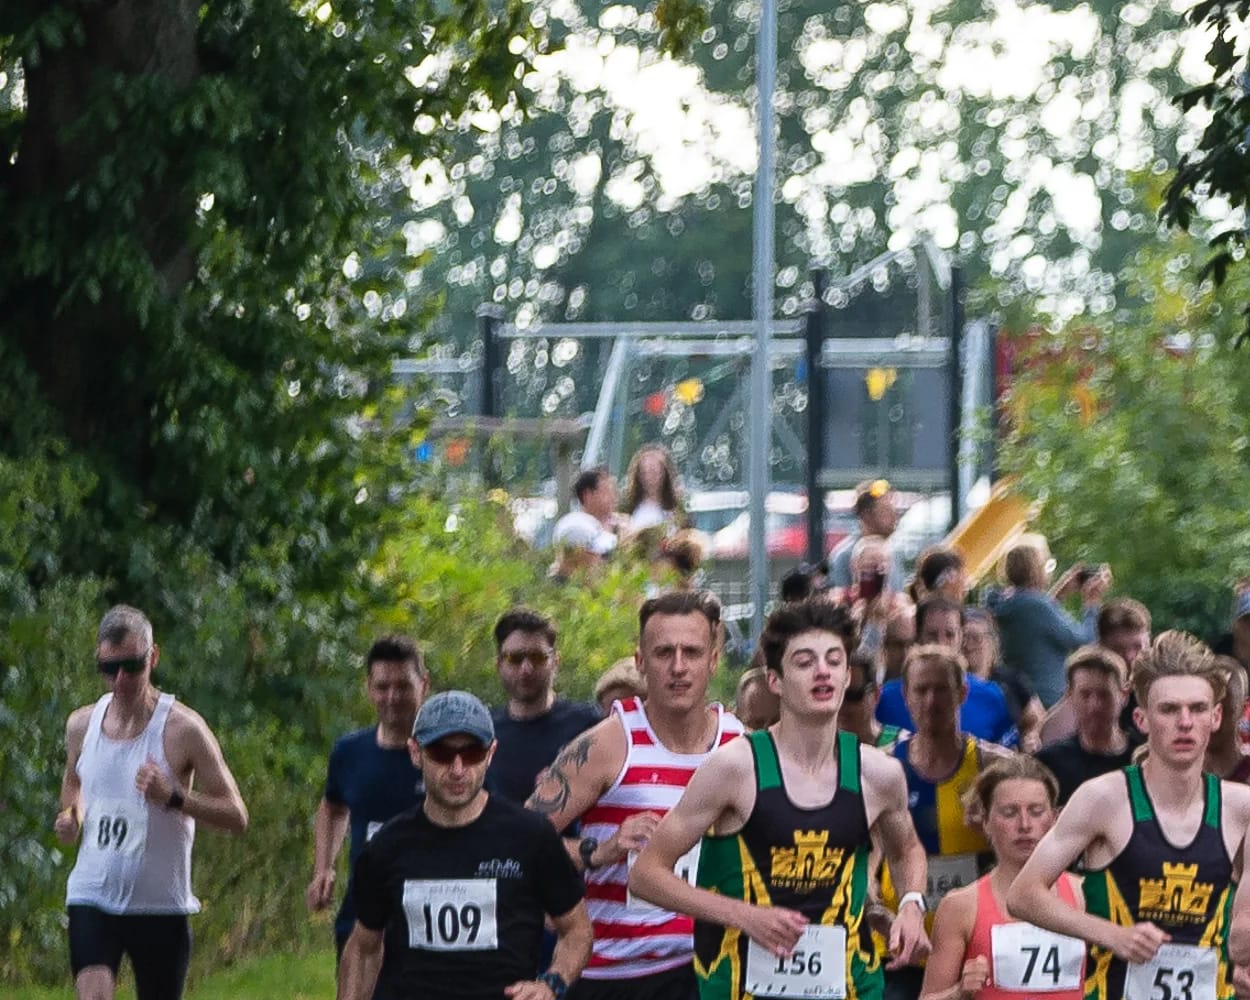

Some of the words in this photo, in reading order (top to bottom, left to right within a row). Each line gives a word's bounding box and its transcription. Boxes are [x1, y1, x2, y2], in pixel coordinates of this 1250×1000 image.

[97, 815, 128, 851] 89
[423, 902, 482, 945] 109
[774, 950, 823, 978] 156
[1020, 945, 1062, 986] 74
